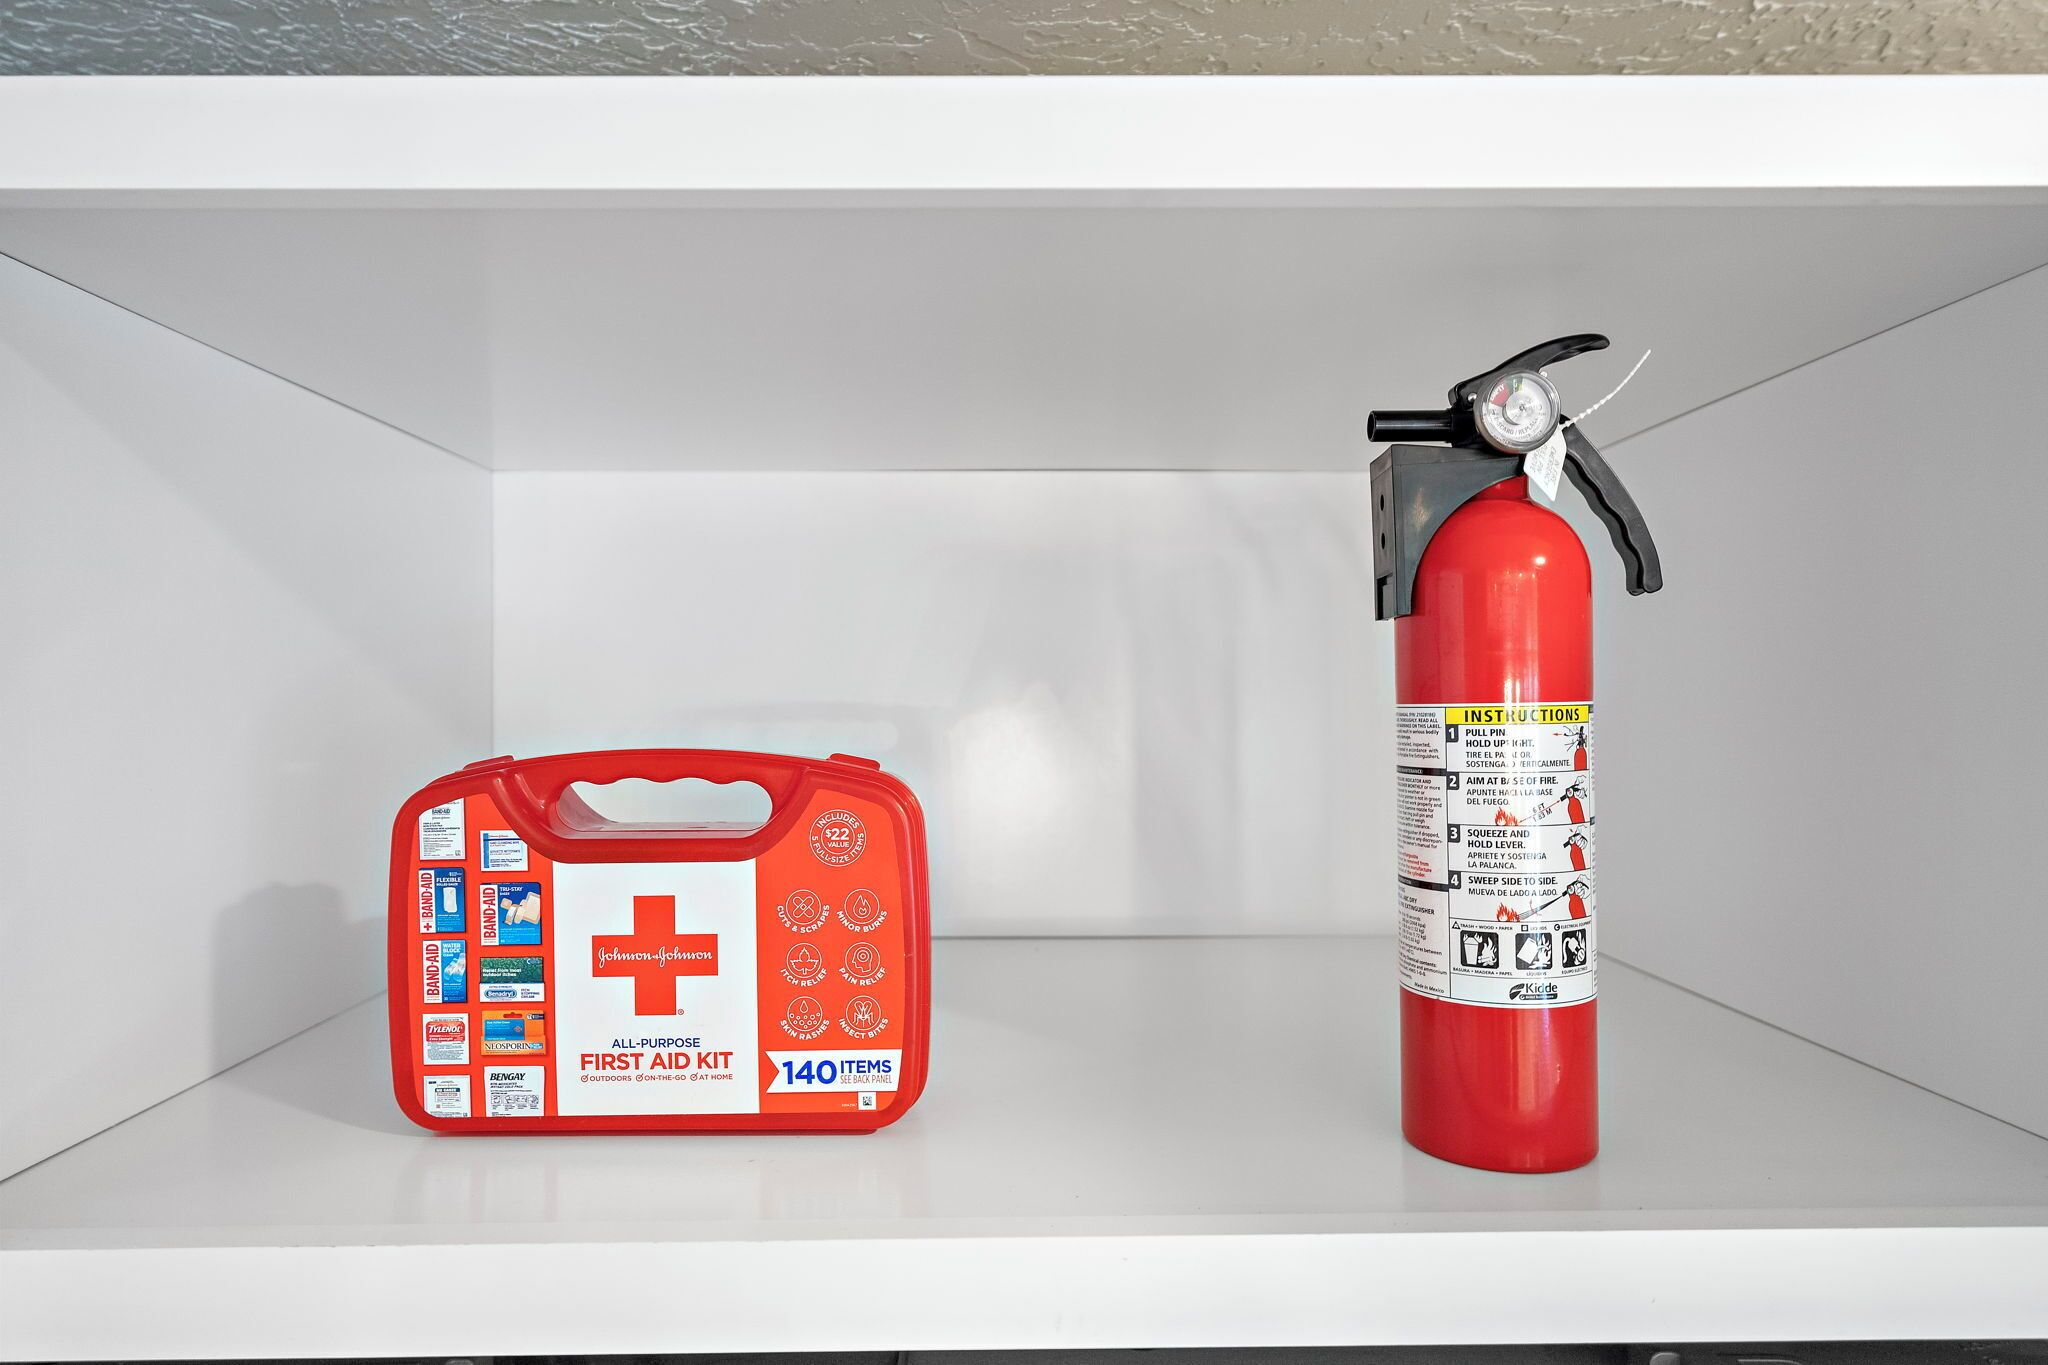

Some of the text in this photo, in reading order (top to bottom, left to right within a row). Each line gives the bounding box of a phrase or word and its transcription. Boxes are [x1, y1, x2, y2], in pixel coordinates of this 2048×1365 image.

[1464, 708, 1580, 722] INSTRUCTIONS
[1449, 727, 1455, 739] 1
[1466, 739, 1535, 748] HOLD UPIGHT.
[1450, 776, 1457, 787] 2
[816, 813, 860, 829] INCLUDES
[1533, 810, 1547, 822] 183
[825, 828, 850, 840] $22
[1450, 828, 1458, 838] 3
[1467, 829, 1507, 837] SQUEEZE
[813, 842, 850, 863] FULL-SIZE
[851, 833, 864, 858] ITEMS
[1450, 875, 1459, 886] 4
[1468, 876, 1499, 884] SWEEP
[1501, 877, 1522, 885] SIDE
[1538, 877, 1558, 885] SIDE.
[421, 873, 433, 917] BAND-AID
[483, 887, 496, 938] BAND-AID
[1405, 904, 1434, 915] EXTINGUISHER
[777, 905, 791, 928] CUTS
[800, 905, 830, 934] SCRAPES
[837, 911, 888, 933] MINOR BURNS
[426, 944, 440, 995] BAND-AID
[780, 968, 828, 987] ITCH RELIEF
[838, 967, 887, 986] PAIN RELIEF
[1429, 985, 1444, 993] Mexico
[1525, 983, 1558, 994] Kidde
[428, 1025, 461, 1033] TYLENOL
[780, 1019, 830, 1040] SKIN RASHES
[838, 1018, 889, 1039] INSECT BITES
[612, 1038, 700, 1048] ALL-PURPOSE
[581, 1052, 733, 1070] FIRST AID KIT
[782, 1060, 892, 1084] 140 ITEMS
[840, 1075, 892, 1084] SEE BACK PANEL
